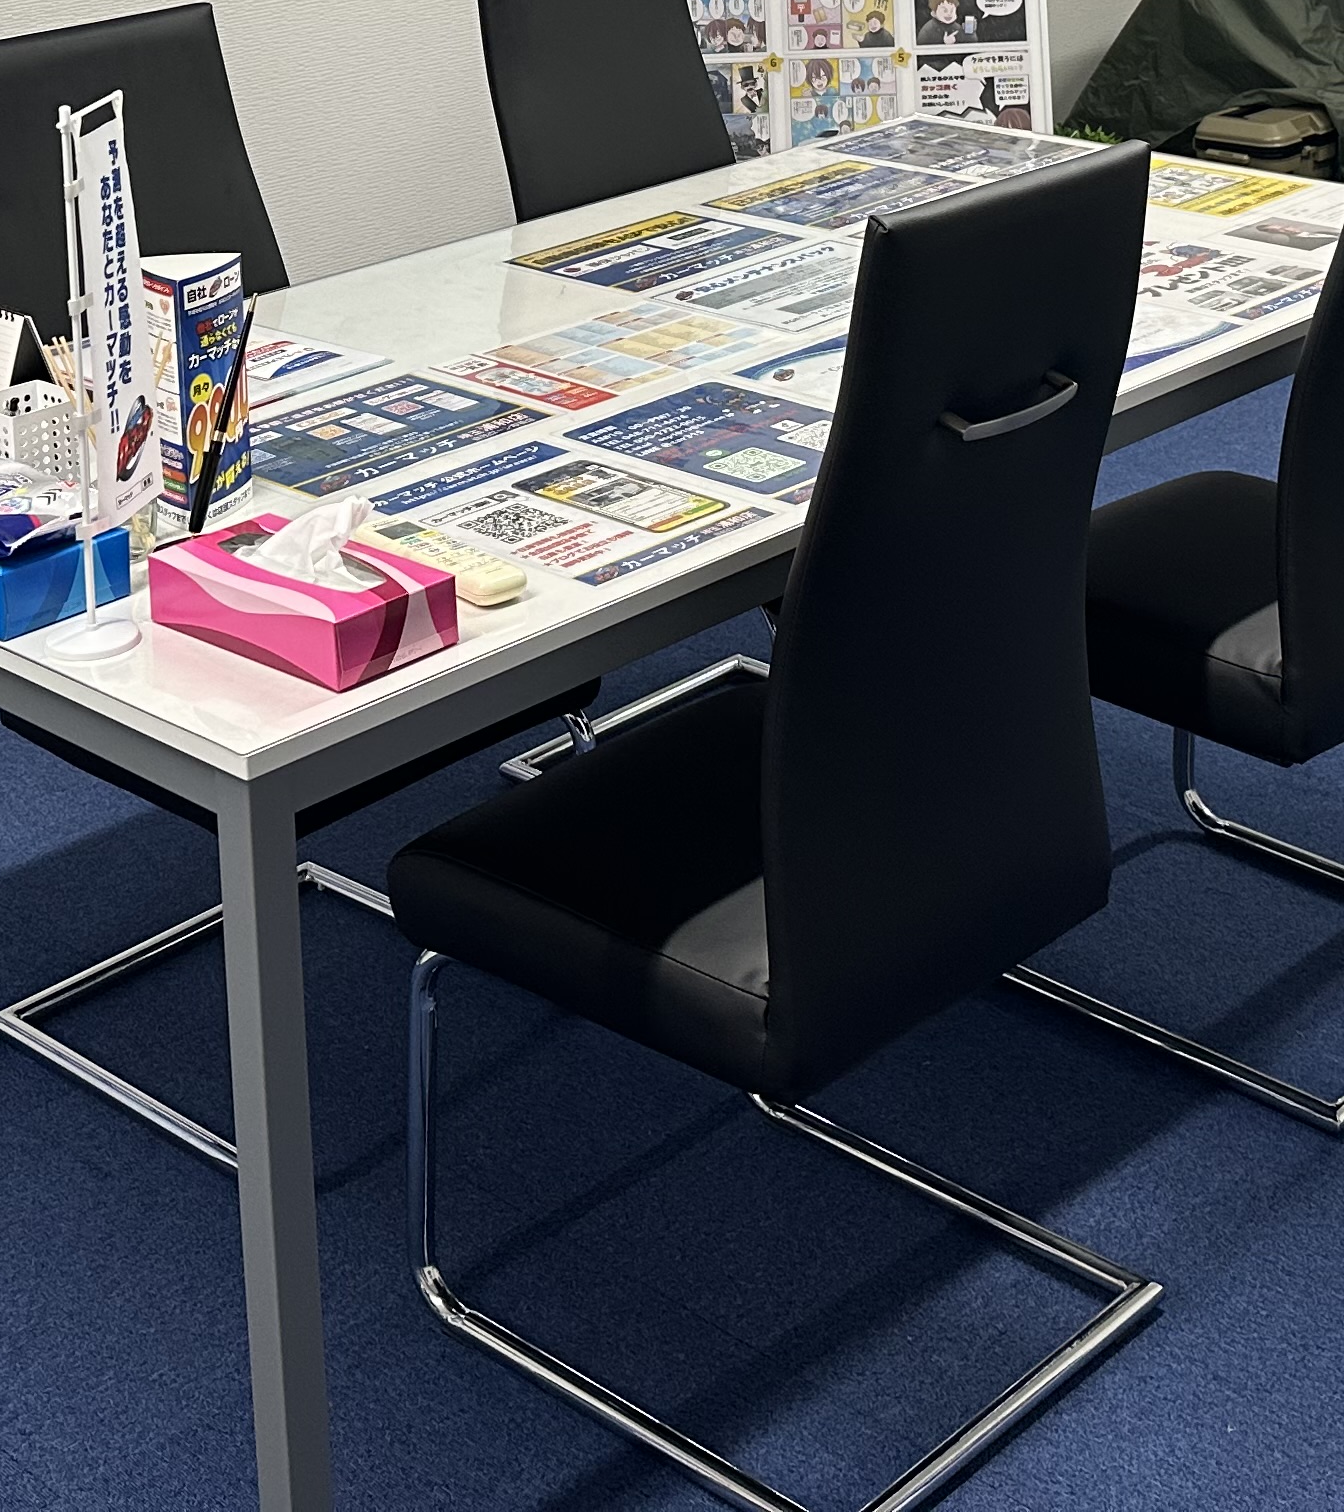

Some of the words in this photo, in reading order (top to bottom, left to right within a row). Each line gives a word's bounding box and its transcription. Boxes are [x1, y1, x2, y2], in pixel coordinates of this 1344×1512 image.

[769, 57, 777, 68] 6
[897, 53, 905, 63] 5
[186, 285, 208, 304] 自社
[192, 381, 210, 397] 月々
[353, 438, 458, 479] カーマッチ
[621, 533, 702, 571] カーマッチ
